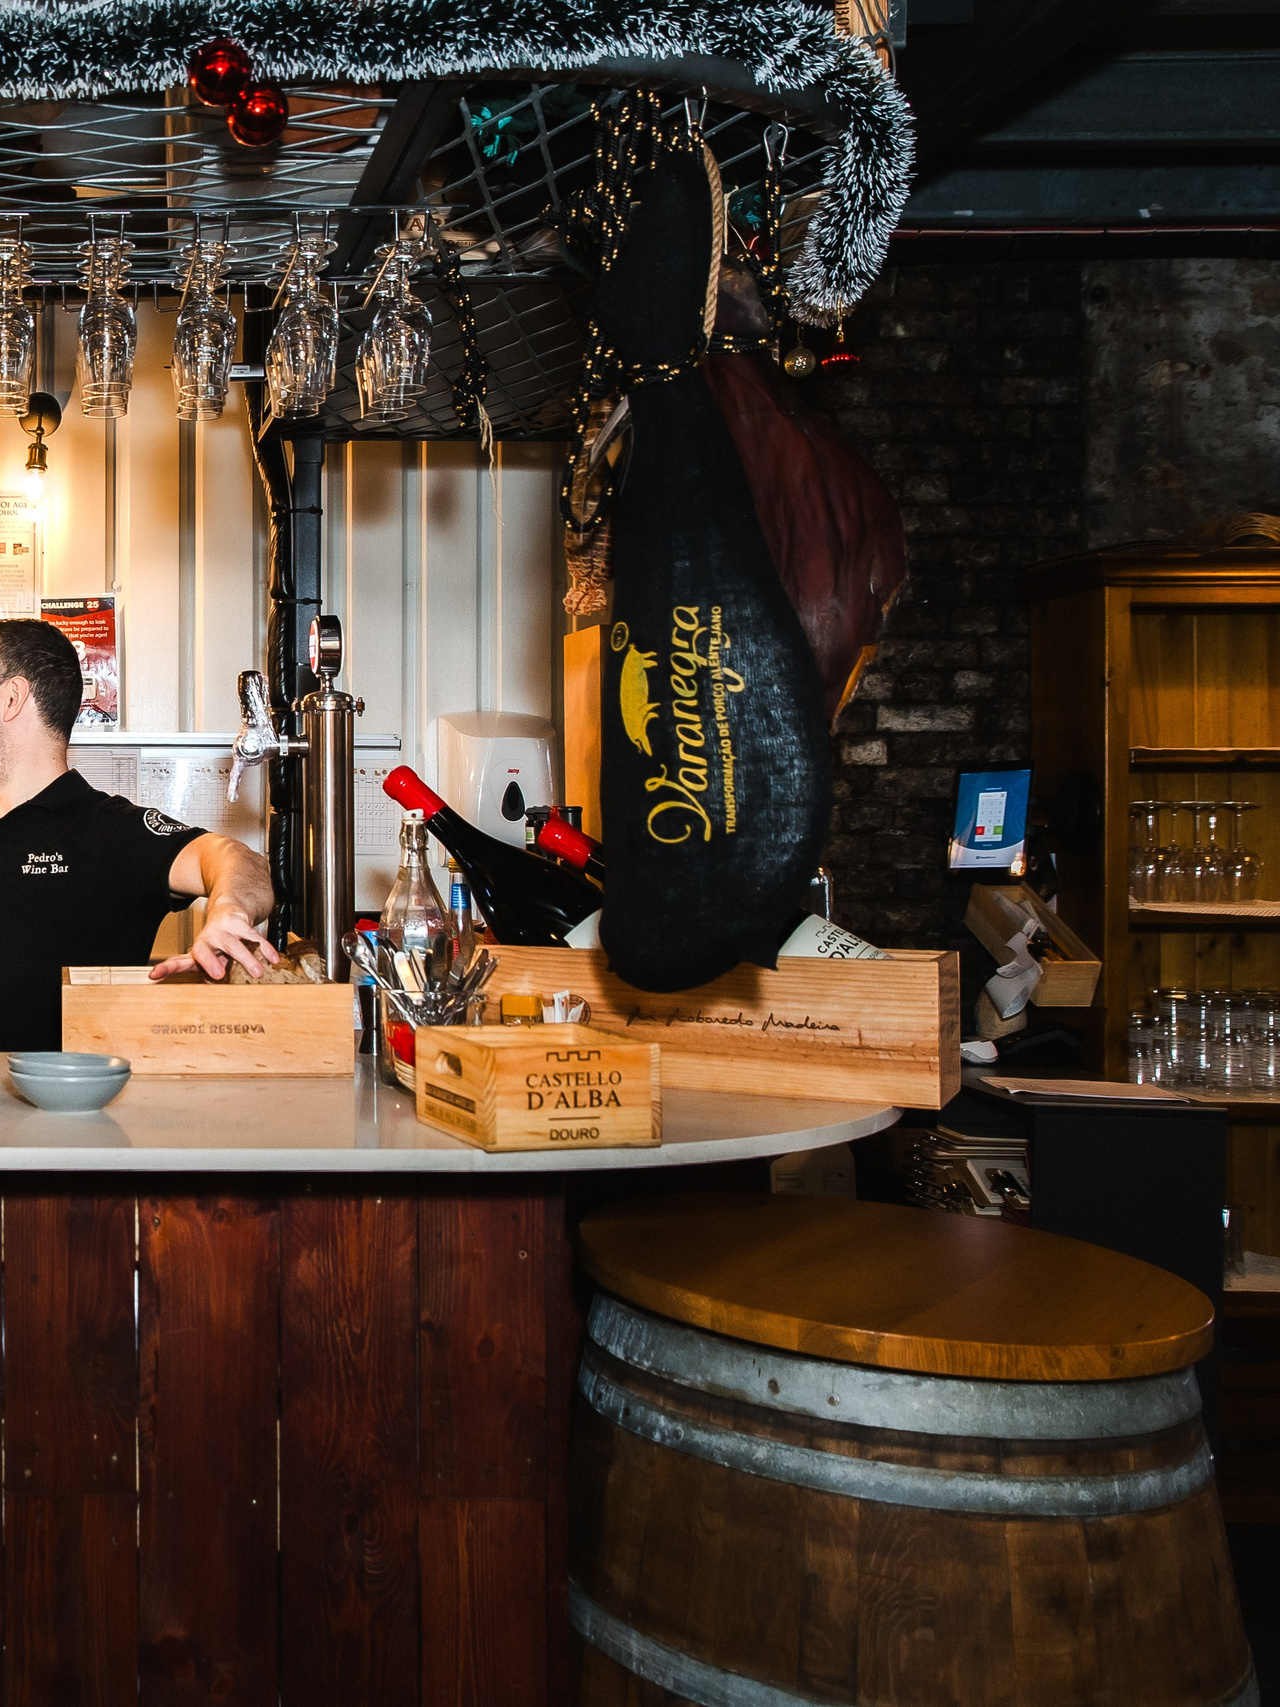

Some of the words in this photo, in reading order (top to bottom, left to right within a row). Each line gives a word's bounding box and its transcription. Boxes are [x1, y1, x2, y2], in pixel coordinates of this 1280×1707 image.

[708, 606, 722, 681] ALENTEJANO
[713, 684, 726, 721] PORCO
[645, 606, 745, 843] Varanegra
[720, 722, 730, 738] DE
[718, 739, 737, 834] TRANSFORMAÇÃO
[27, 852, 63, 864] Pedro's
[21, 865, 47, 874] Wine
[50, 864, 69, 874] Bar
[817, 928, 847, 953] CASTE
[151, 1024, 205, 1035] GRANDE
[210, 1024, 265, 1034] RESERVA
[526, 1070, 622, 1089] CASTELLO
[549, 1127, 600, 1141] DOURO
